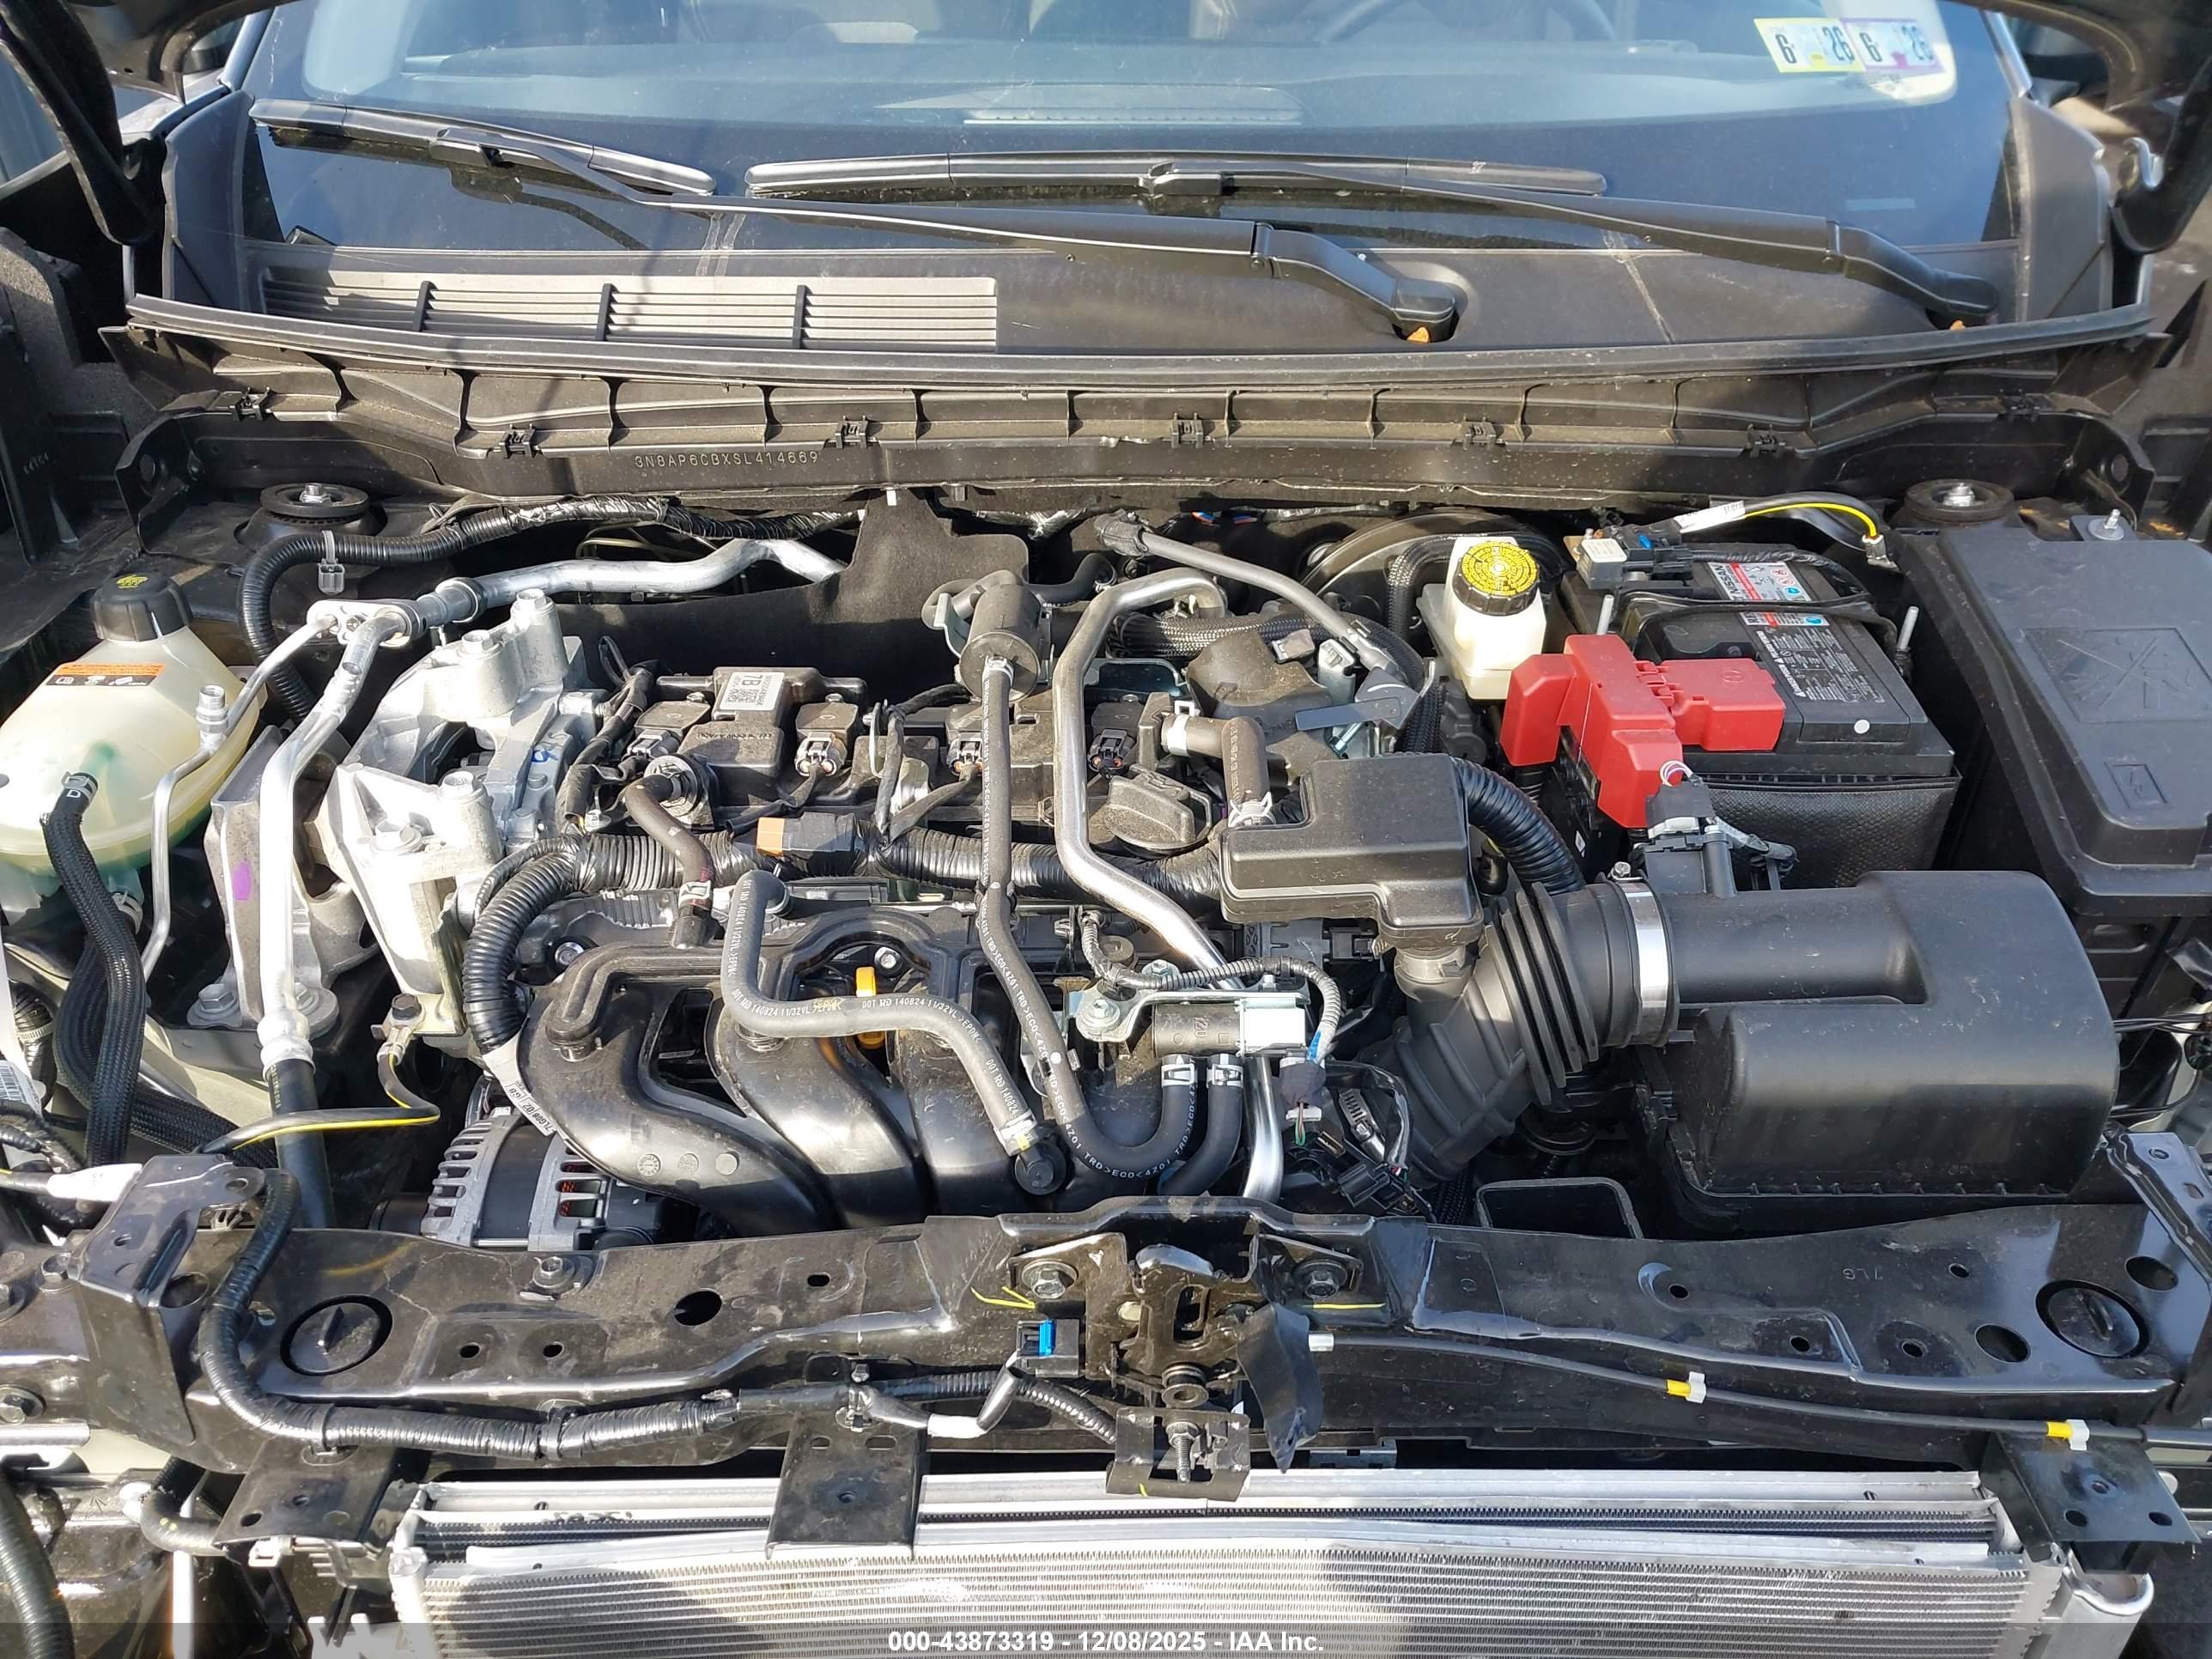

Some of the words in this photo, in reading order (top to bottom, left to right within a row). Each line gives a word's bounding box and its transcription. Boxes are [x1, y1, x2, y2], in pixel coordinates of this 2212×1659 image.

[1775, 33, 1797, 64] 6
[1821, 26, 1856, 62] 26
[1859, 32, 1883, 63] 6
[634, 451, 818, 468] 3N8AP6CBXSL414669
[1714, 564, 1741, 594] NISSAN
